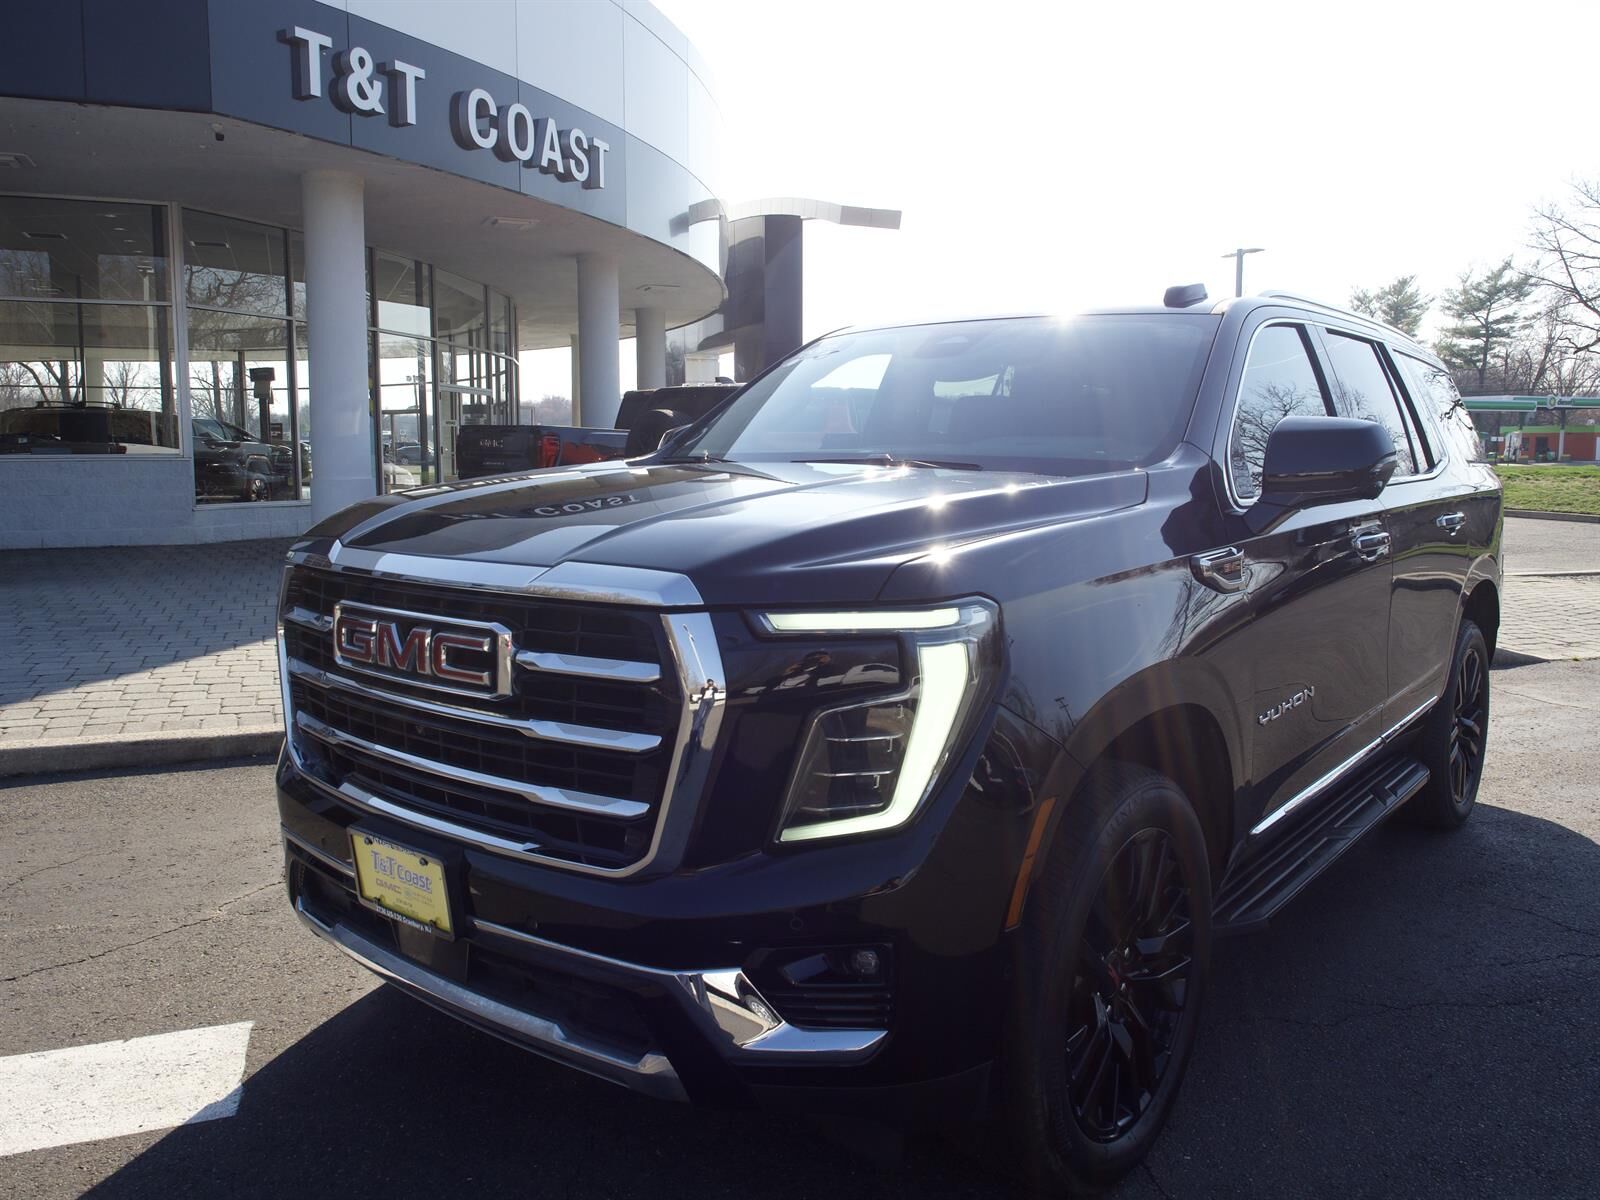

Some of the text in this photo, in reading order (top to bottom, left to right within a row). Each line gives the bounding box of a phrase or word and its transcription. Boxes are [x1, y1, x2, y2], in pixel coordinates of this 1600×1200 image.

[292, 26, 609, 189] T&T COAST
[336, 614, 491, 687] GMC
[1258, 686, 1315, 726] YUKON
[371, 850, 432, 892] T&T Coast
[375, 877, 402, 894] GMC
